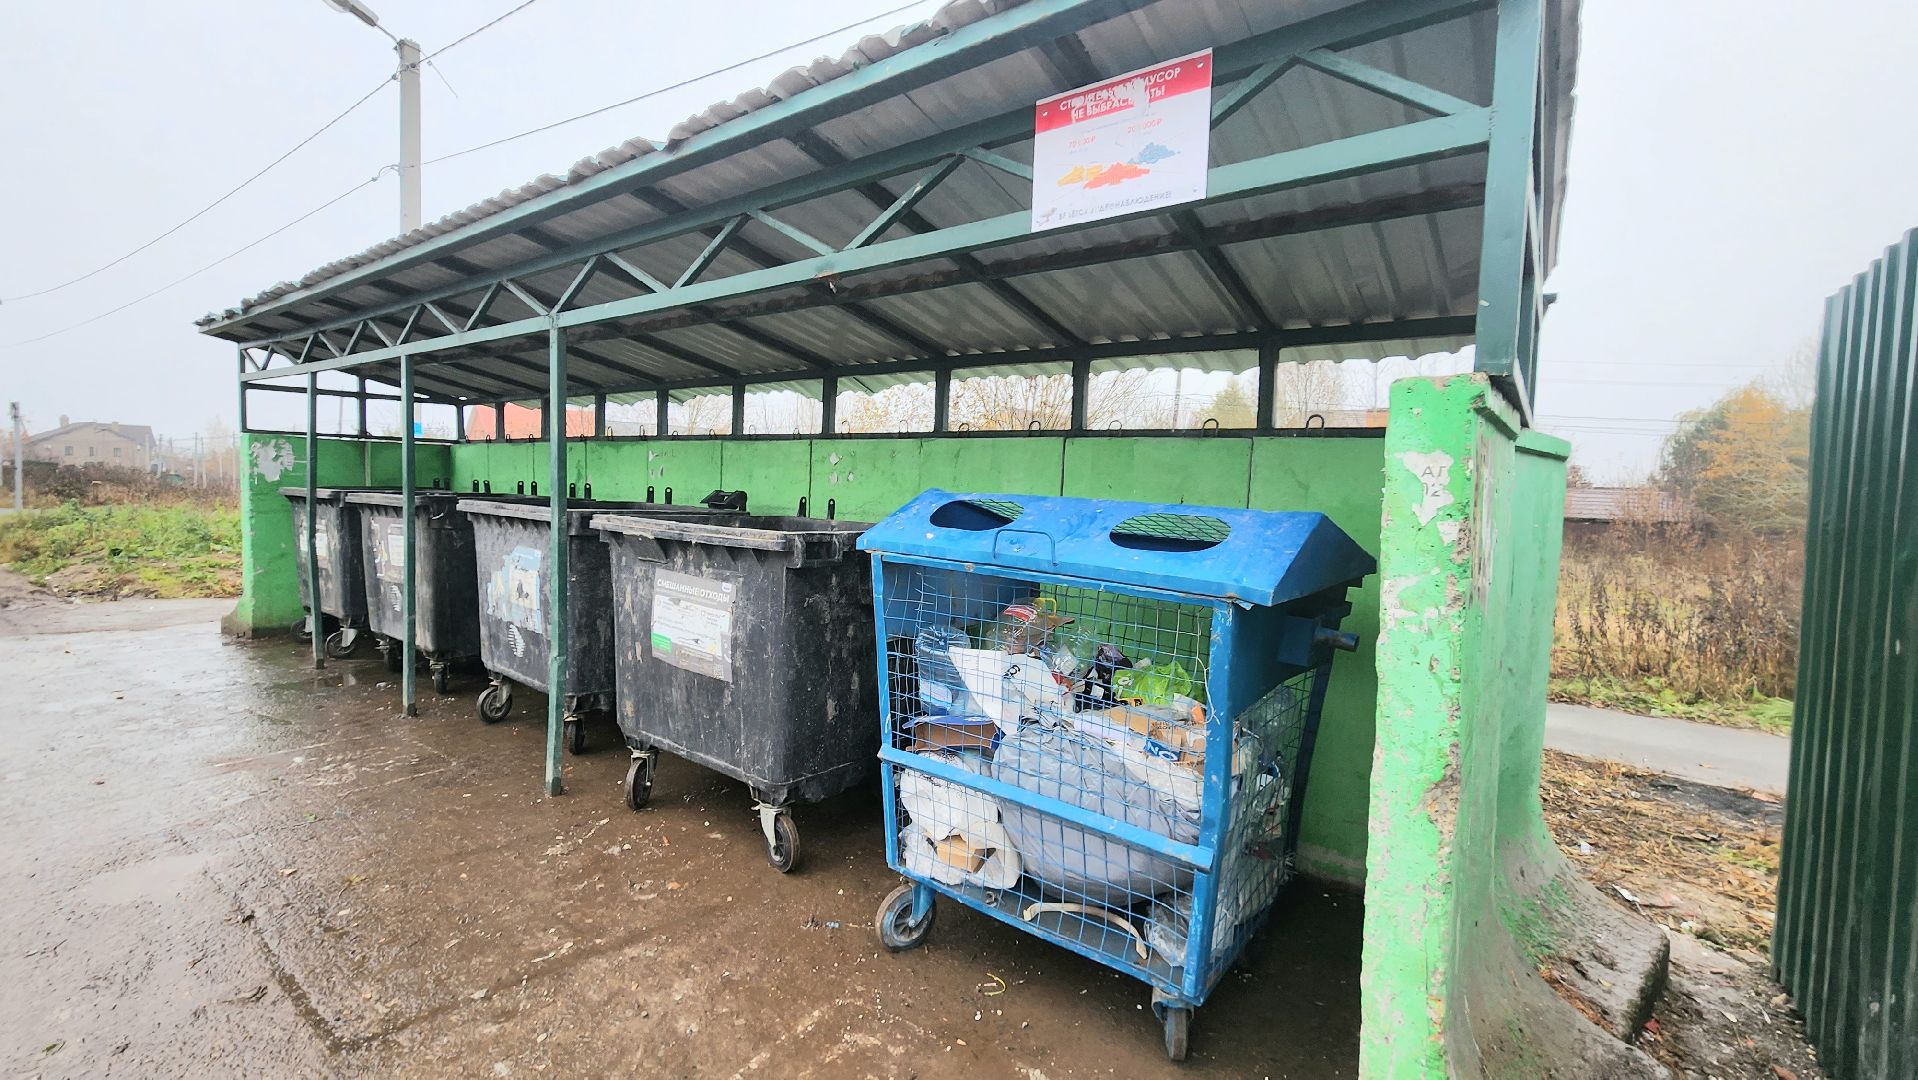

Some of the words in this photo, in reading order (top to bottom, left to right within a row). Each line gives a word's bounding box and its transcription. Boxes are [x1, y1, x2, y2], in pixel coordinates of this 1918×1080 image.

[1072, 107, 1086, 119] НЕ
[1087, 85, 1166, 117] ВЫБРАСТЬ!
[657, 578, 699, 596] СМЕШАННЫЕ
[700, 588, 730, 603] ОТХОДЫ
